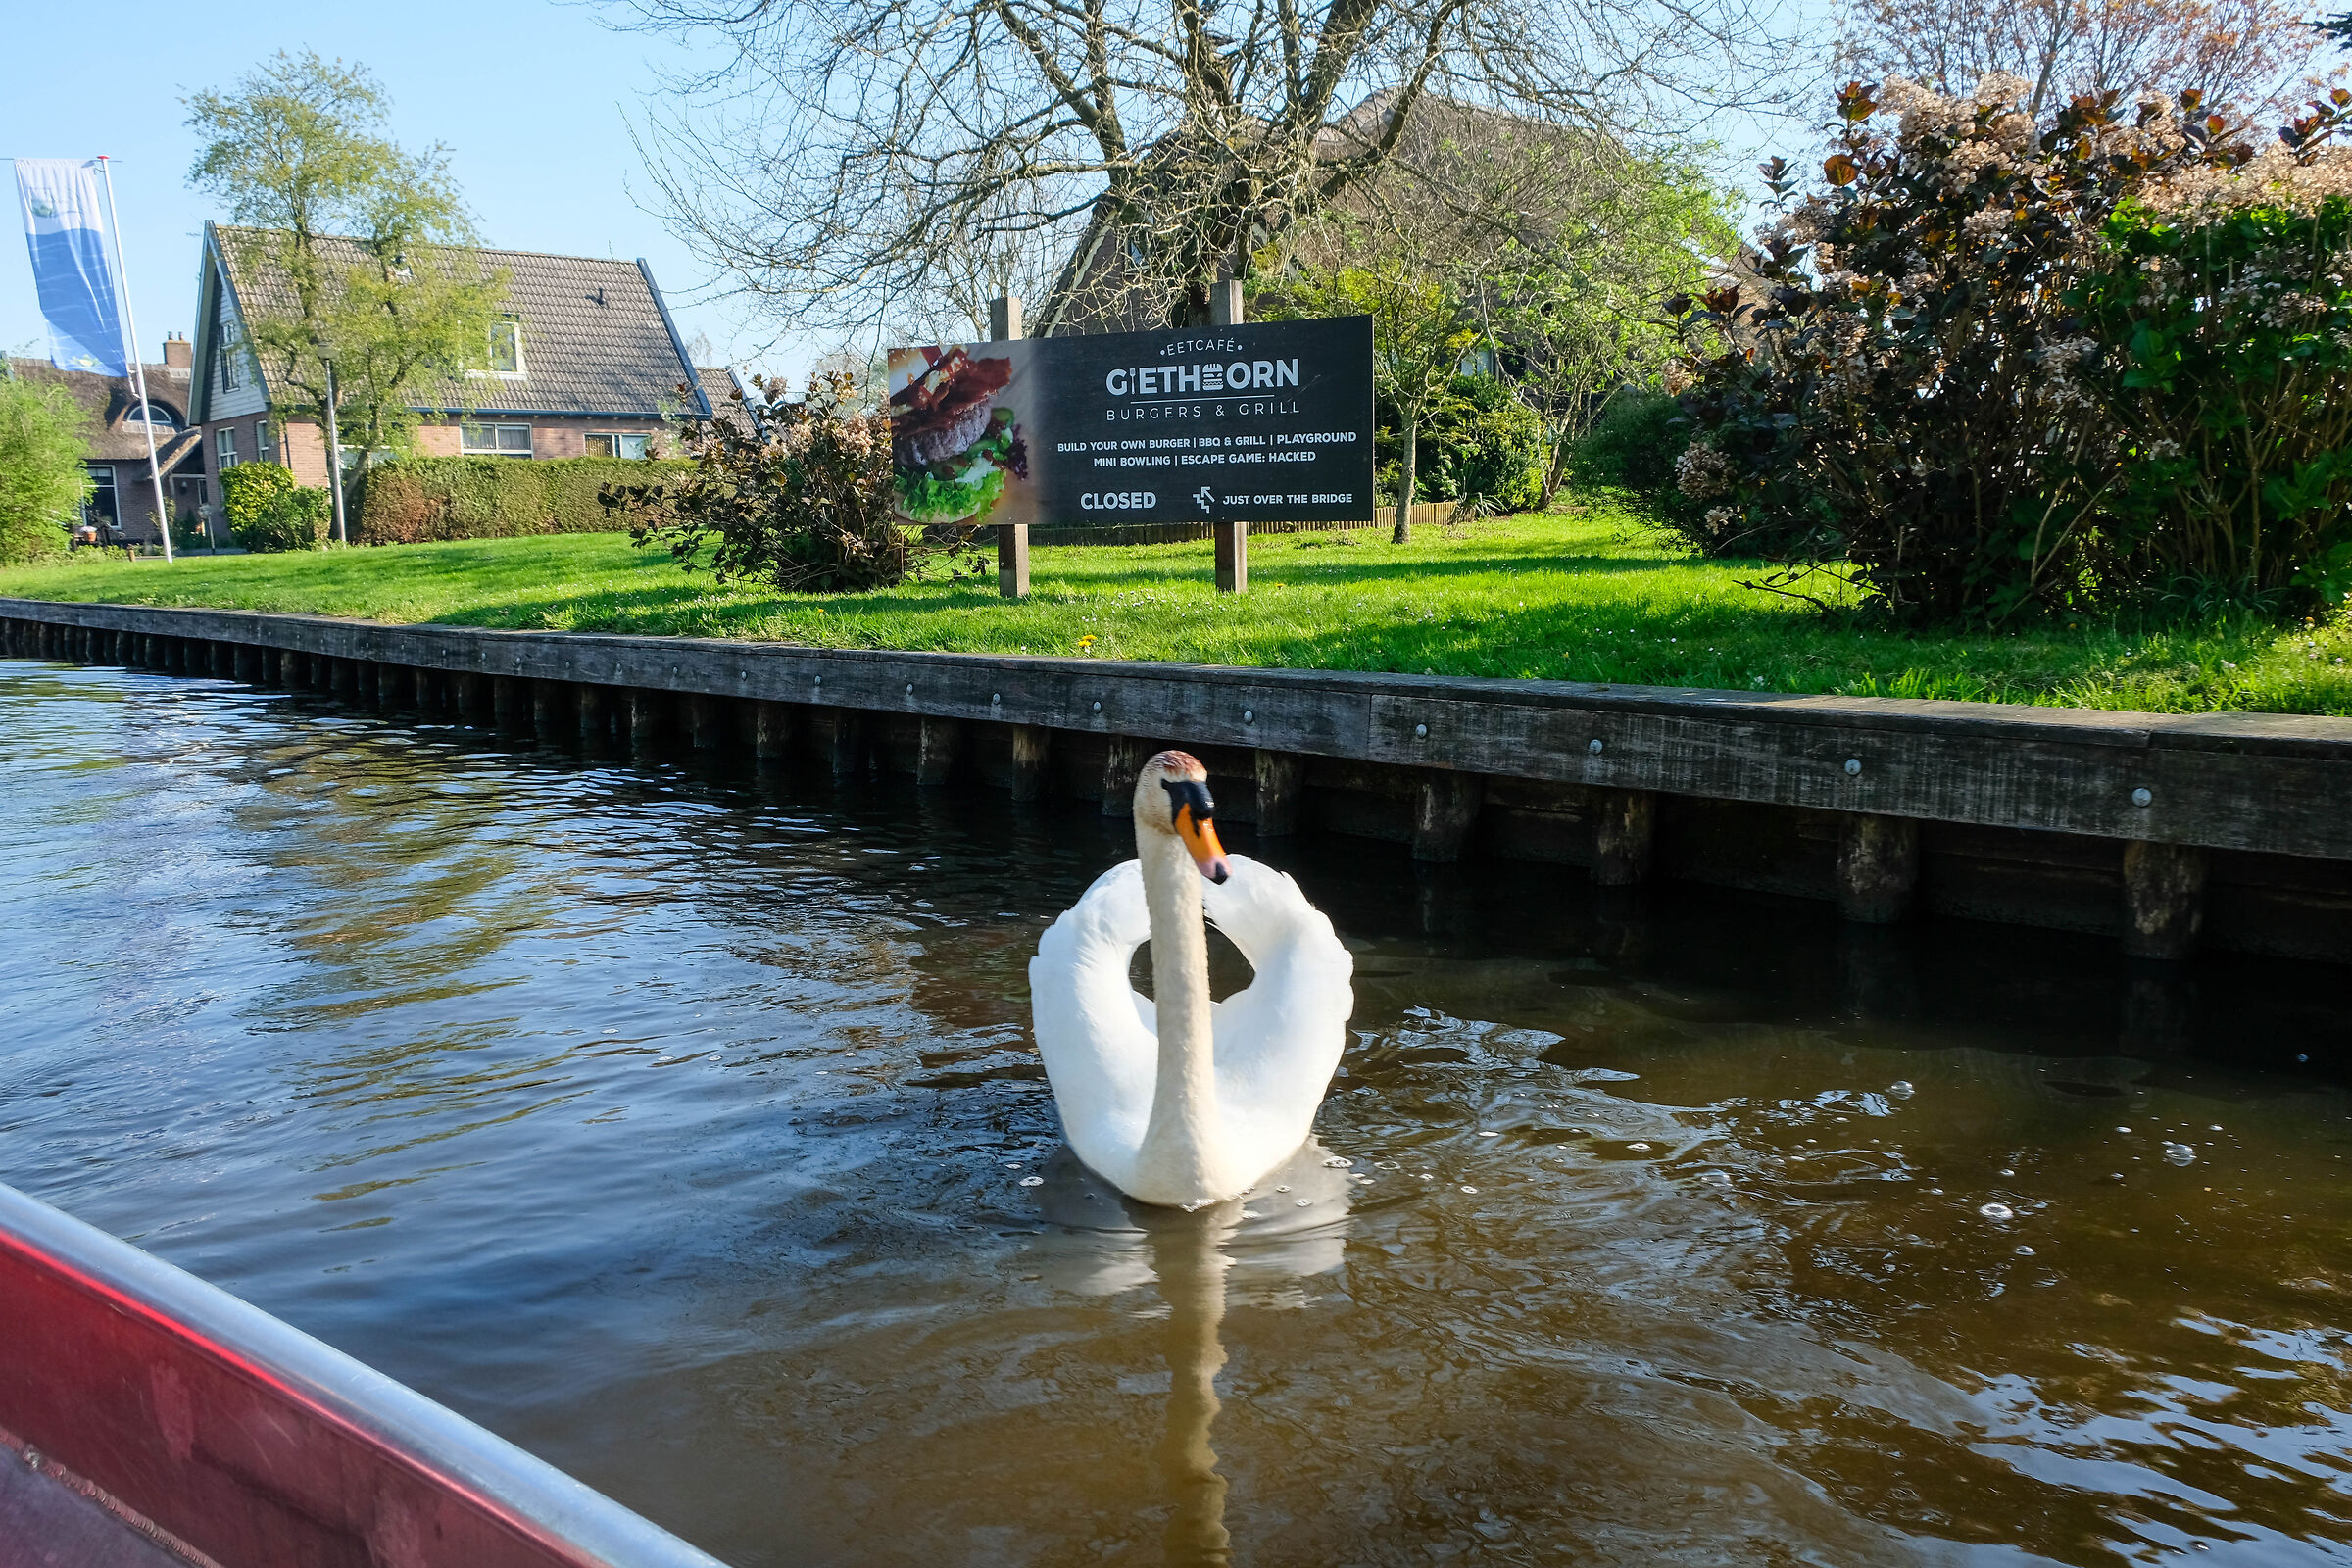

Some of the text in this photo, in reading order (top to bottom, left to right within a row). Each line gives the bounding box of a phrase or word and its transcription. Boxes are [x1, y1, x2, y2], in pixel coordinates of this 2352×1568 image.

[1107, 400, 1299, 420] BURGERS & GRILL
[1090, 441, 1117, 450] YOUR
[1121, 440, 1145, 449] OWN
[1150, 439, 1190, 448] BURGER
[1199, 437, 1220, 446] BBQ
[1224, 437, 1231, 446] &
[1235, 436, 1265, 445] GRILL
[1277, 432, 1356, 444] PLAYGROUND
[1094, 458, 1116, 466] MINI
[1120, 456, 1170, 466] BOWLING
[1182, 454, 1224, 464] ESCAPE
[1229, 453, 1265, 463] GAME:
[1269, 452, 1315, 462] HACKED
[1081, 492, 1156, 509] CLOSED
[1223, 495, 1250, 504] JUST
[1254, 495, 1283, 504] OVER
[1312, 494, 1352, 503] BRIDGE
